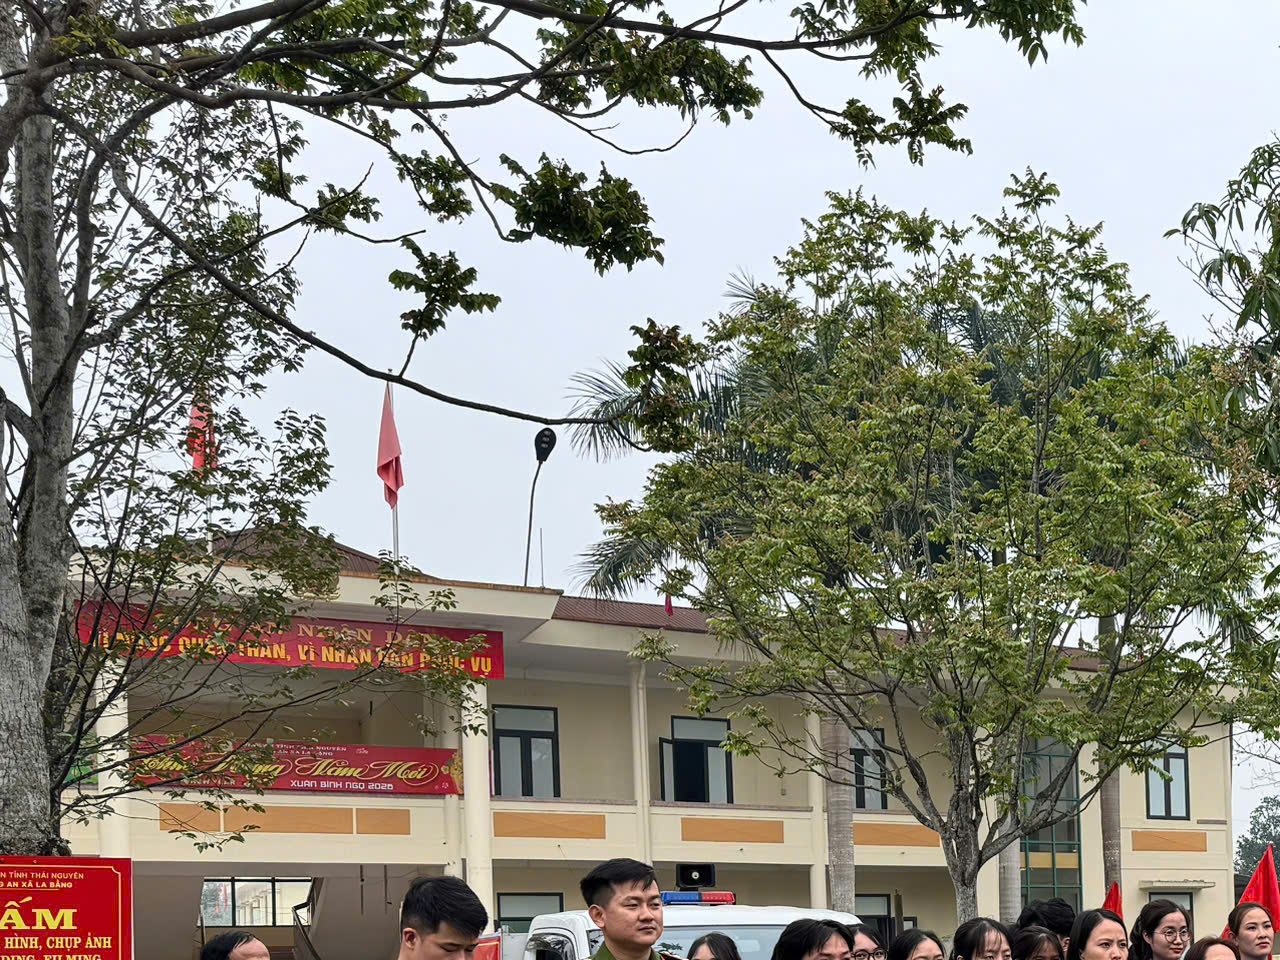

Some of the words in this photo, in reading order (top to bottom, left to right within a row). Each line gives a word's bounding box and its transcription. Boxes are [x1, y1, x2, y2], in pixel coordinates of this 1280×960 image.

[297, 641, 316, 662] VÌ
[470, 656, 492, 679] VỤ
[22, 880, 33, 888] XÃ
[50, 879, 73, 889] BẰNG
[30, 871, 49, 879] THÁI
[51, 871, 84, 879] NGUYÊN
[0, 896, 78, 930] ẤM
[4, 932, 42, 951] HÌNH,
[46, 936, 82, 952] CHỤP
[85, 931, 112, 949] ẢNH
